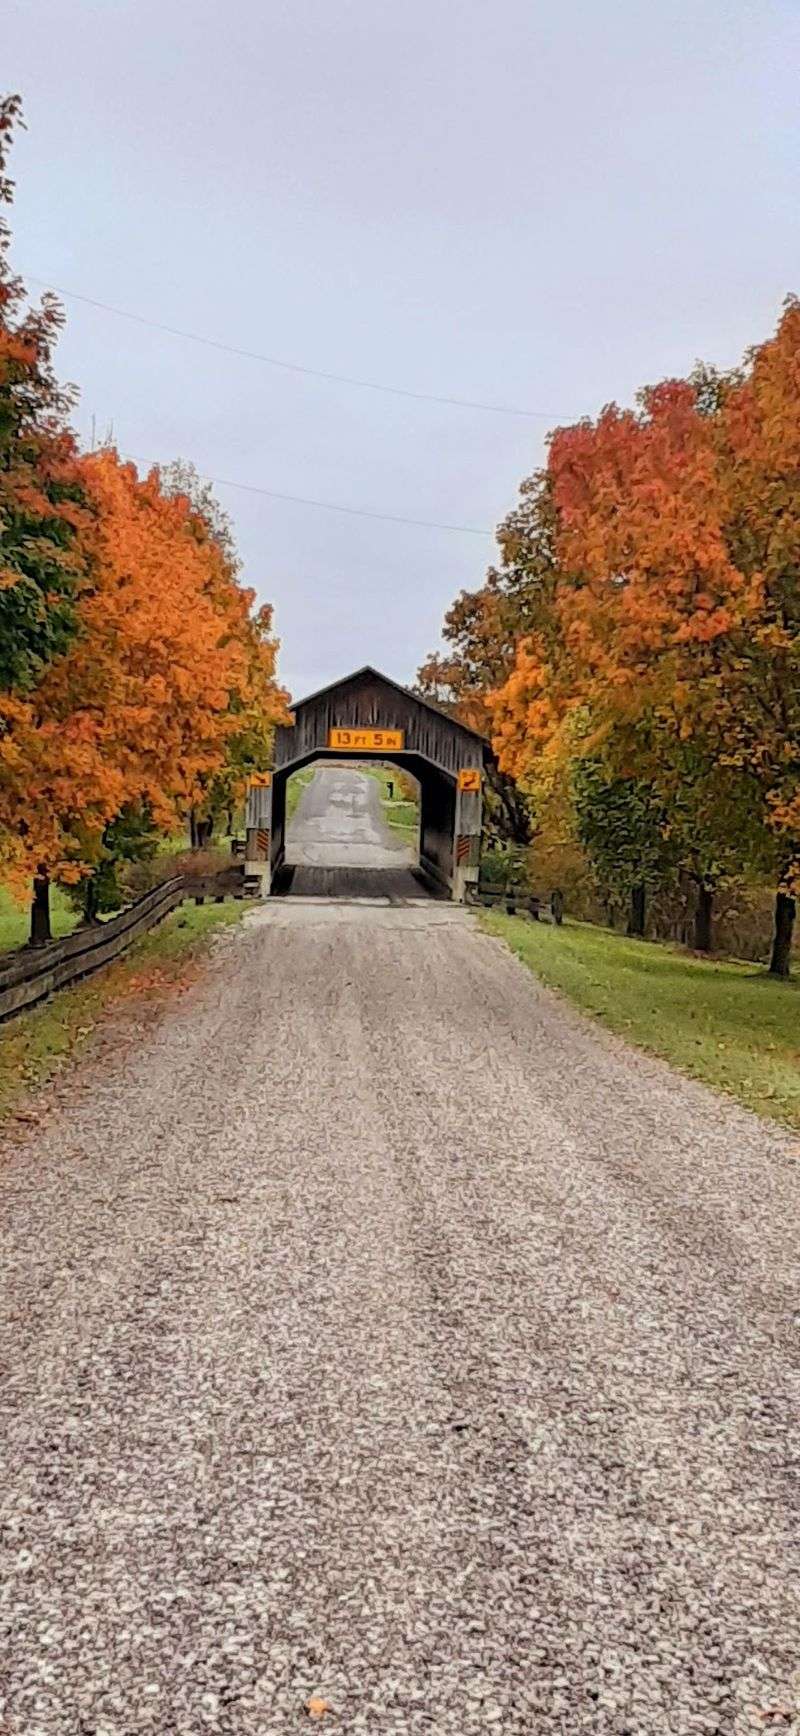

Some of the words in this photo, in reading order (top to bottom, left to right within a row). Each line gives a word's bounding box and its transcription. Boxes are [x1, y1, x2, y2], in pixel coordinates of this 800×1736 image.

[337, 732, 351, 745] 13
[354, 736, 366, 745] FT
[373, 733, 384, 745] 5
[386, 737, 397, 746] IN
